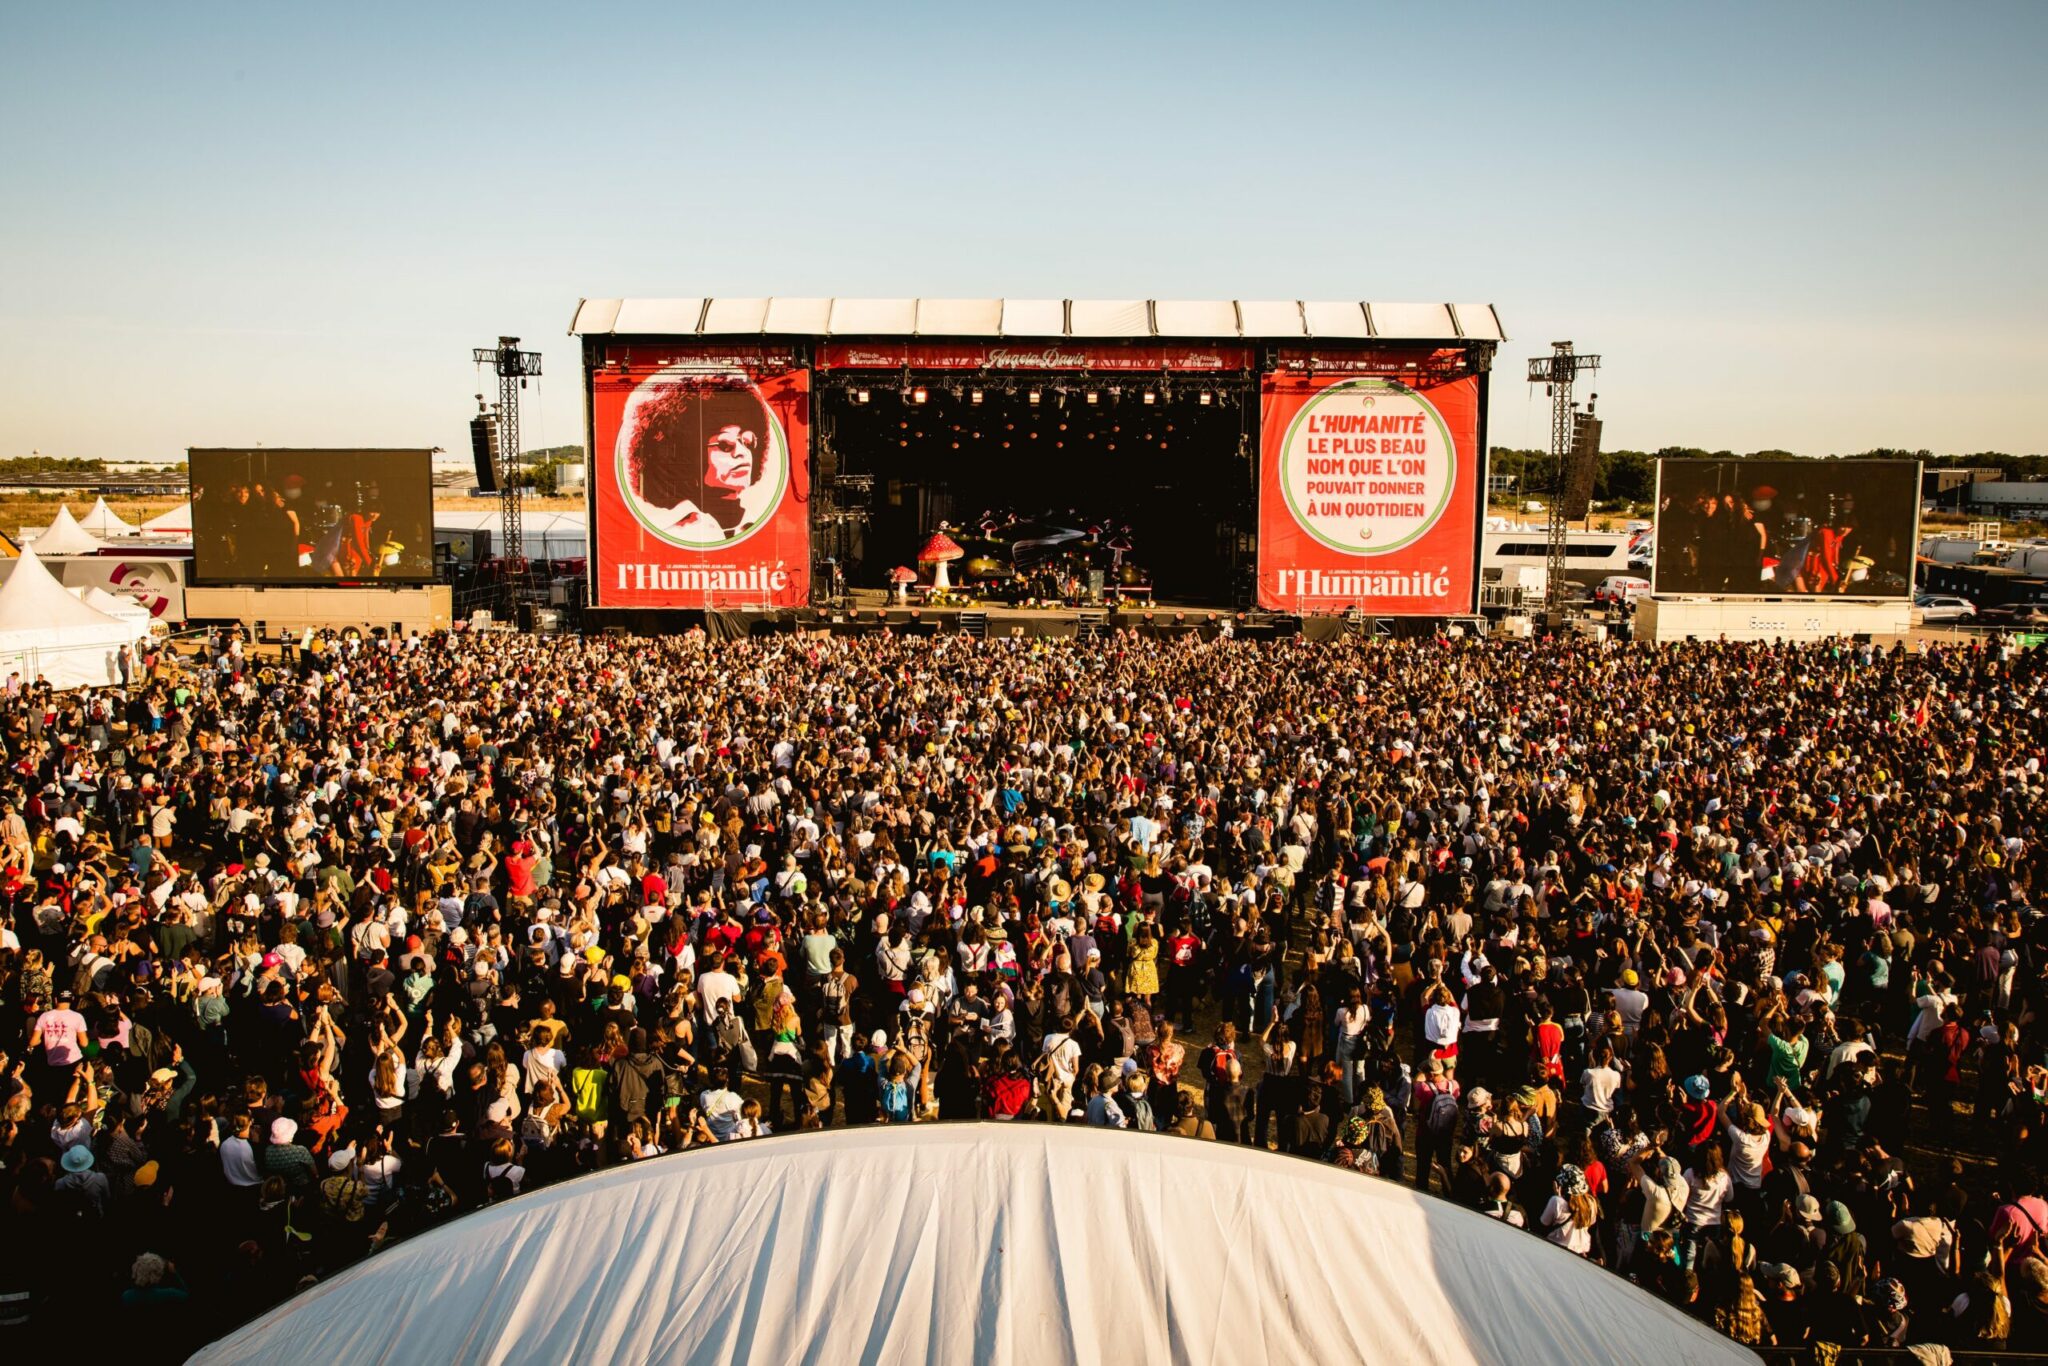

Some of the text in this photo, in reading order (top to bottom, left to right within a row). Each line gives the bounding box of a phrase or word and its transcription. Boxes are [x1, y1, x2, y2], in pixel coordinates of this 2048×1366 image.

[988, 347, 1084, 368] Angela Davis
[1307, 411, 1426, 434] L'HUMANITÉ
[1307, 438, 1426, 454] LE PLUS BEAU
[1307, 459, 1425, 476] NOM QUE L'ON
[1307, 481, 1425, 495] POUVAIT DONNER
[1307, 499, 1424, 518] À UN QUOTIDIEN
[617, 560, 787, 591] l'Humanité
[1277, 566, 1450, 597] l'Humanité
